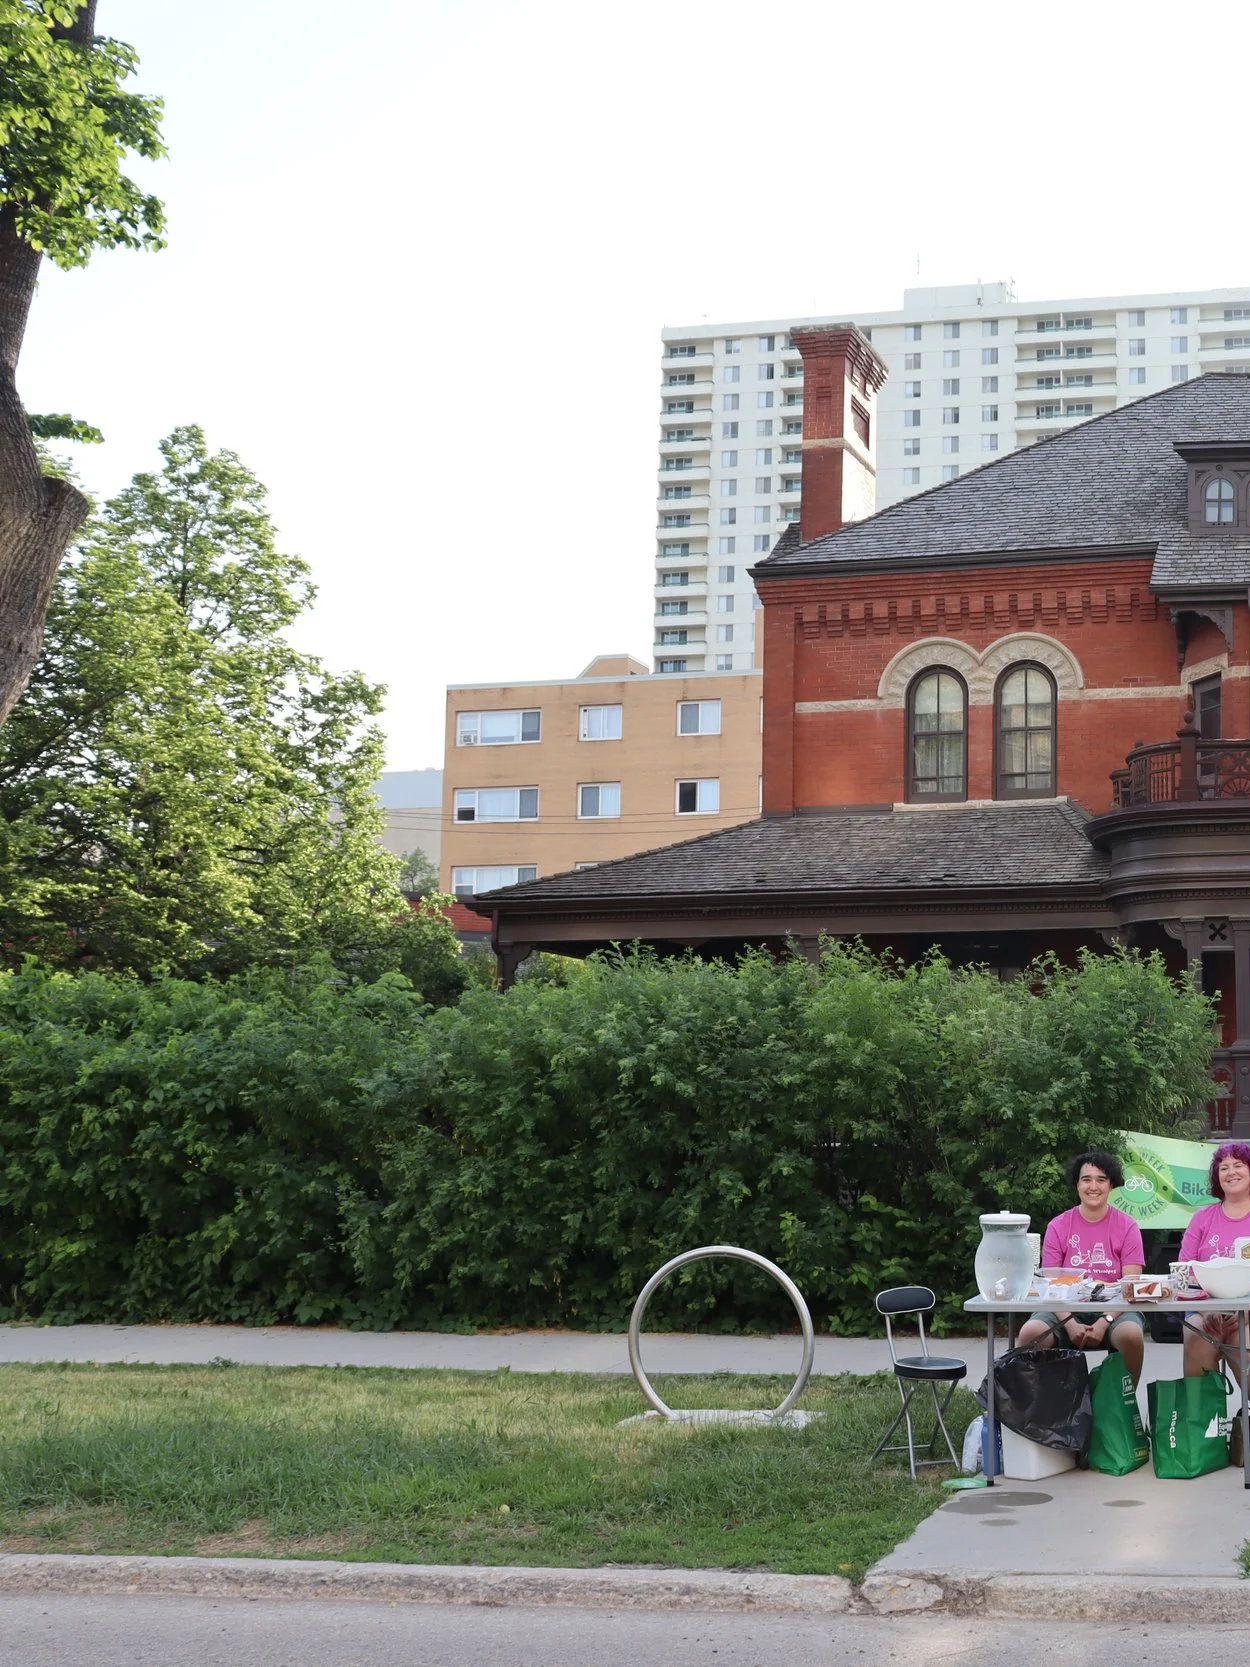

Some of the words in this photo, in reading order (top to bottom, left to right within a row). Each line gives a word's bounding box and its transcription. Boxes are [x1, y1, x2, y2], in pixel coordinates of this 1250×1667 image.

[1113, 1196, 1135, 1216] BIKE
[1138, 1197, 1165, 1216] WEEK
[1169, 1410, 1178, 1449] mec.ca
